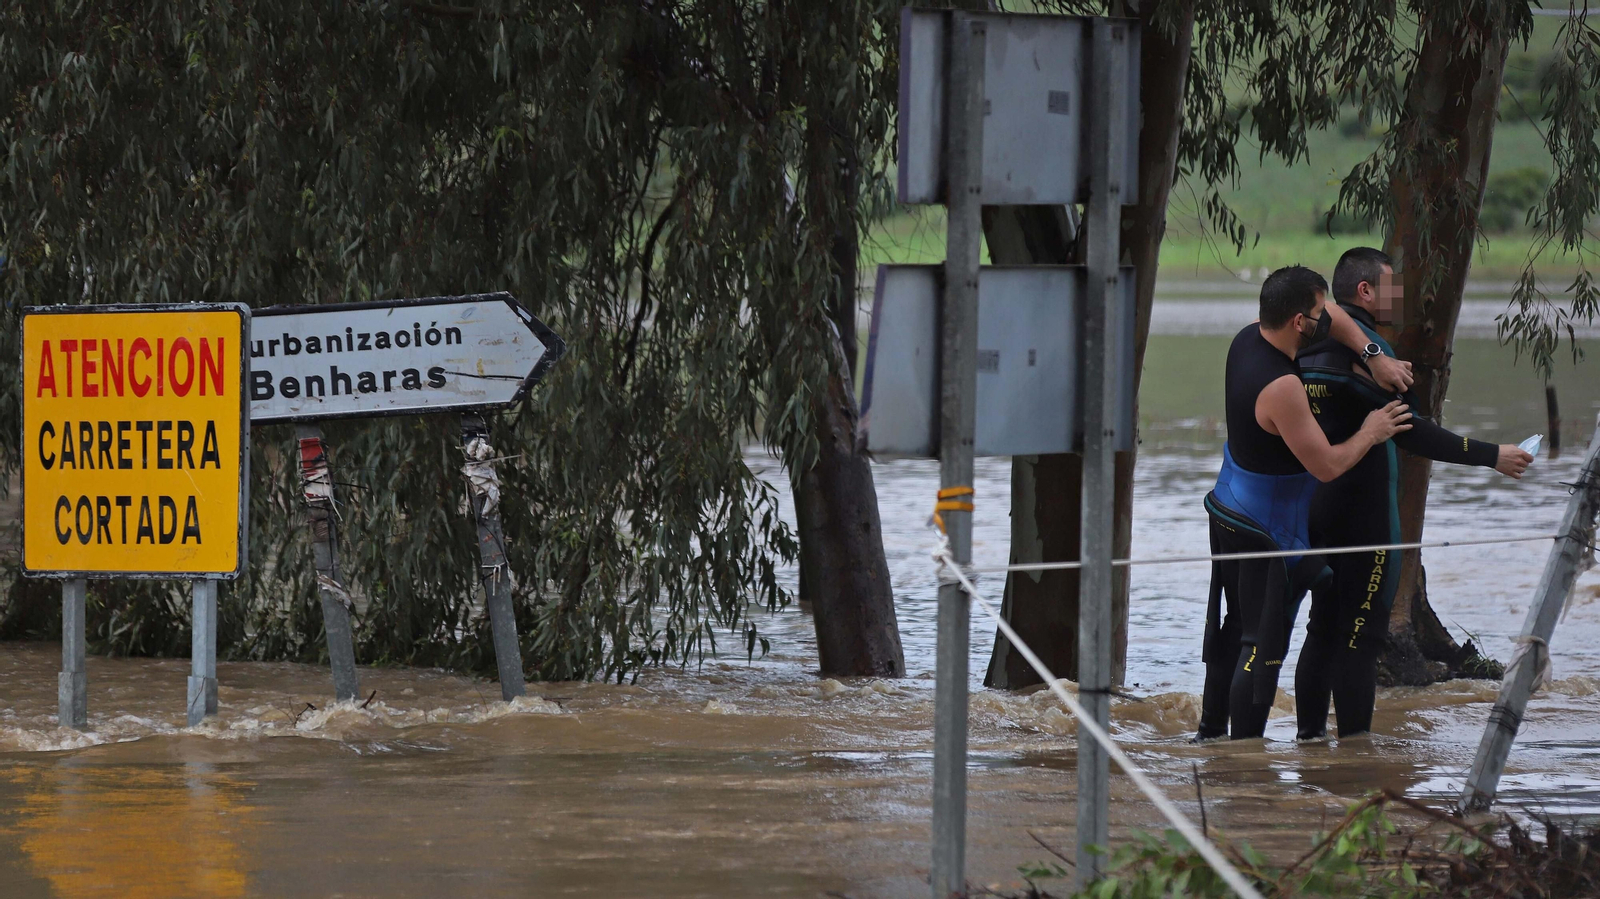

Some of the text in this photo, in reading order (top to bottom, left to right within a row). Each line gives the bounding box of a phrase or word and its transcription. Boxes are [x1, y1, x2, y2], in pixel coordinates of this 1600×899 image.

[36, 336, 225, 398] ATENCION
[250, 365, 447, 401] Benharas
[38, 420, 222, 471] CARRETERA
[54, 494, 202, 545] CORTADA
